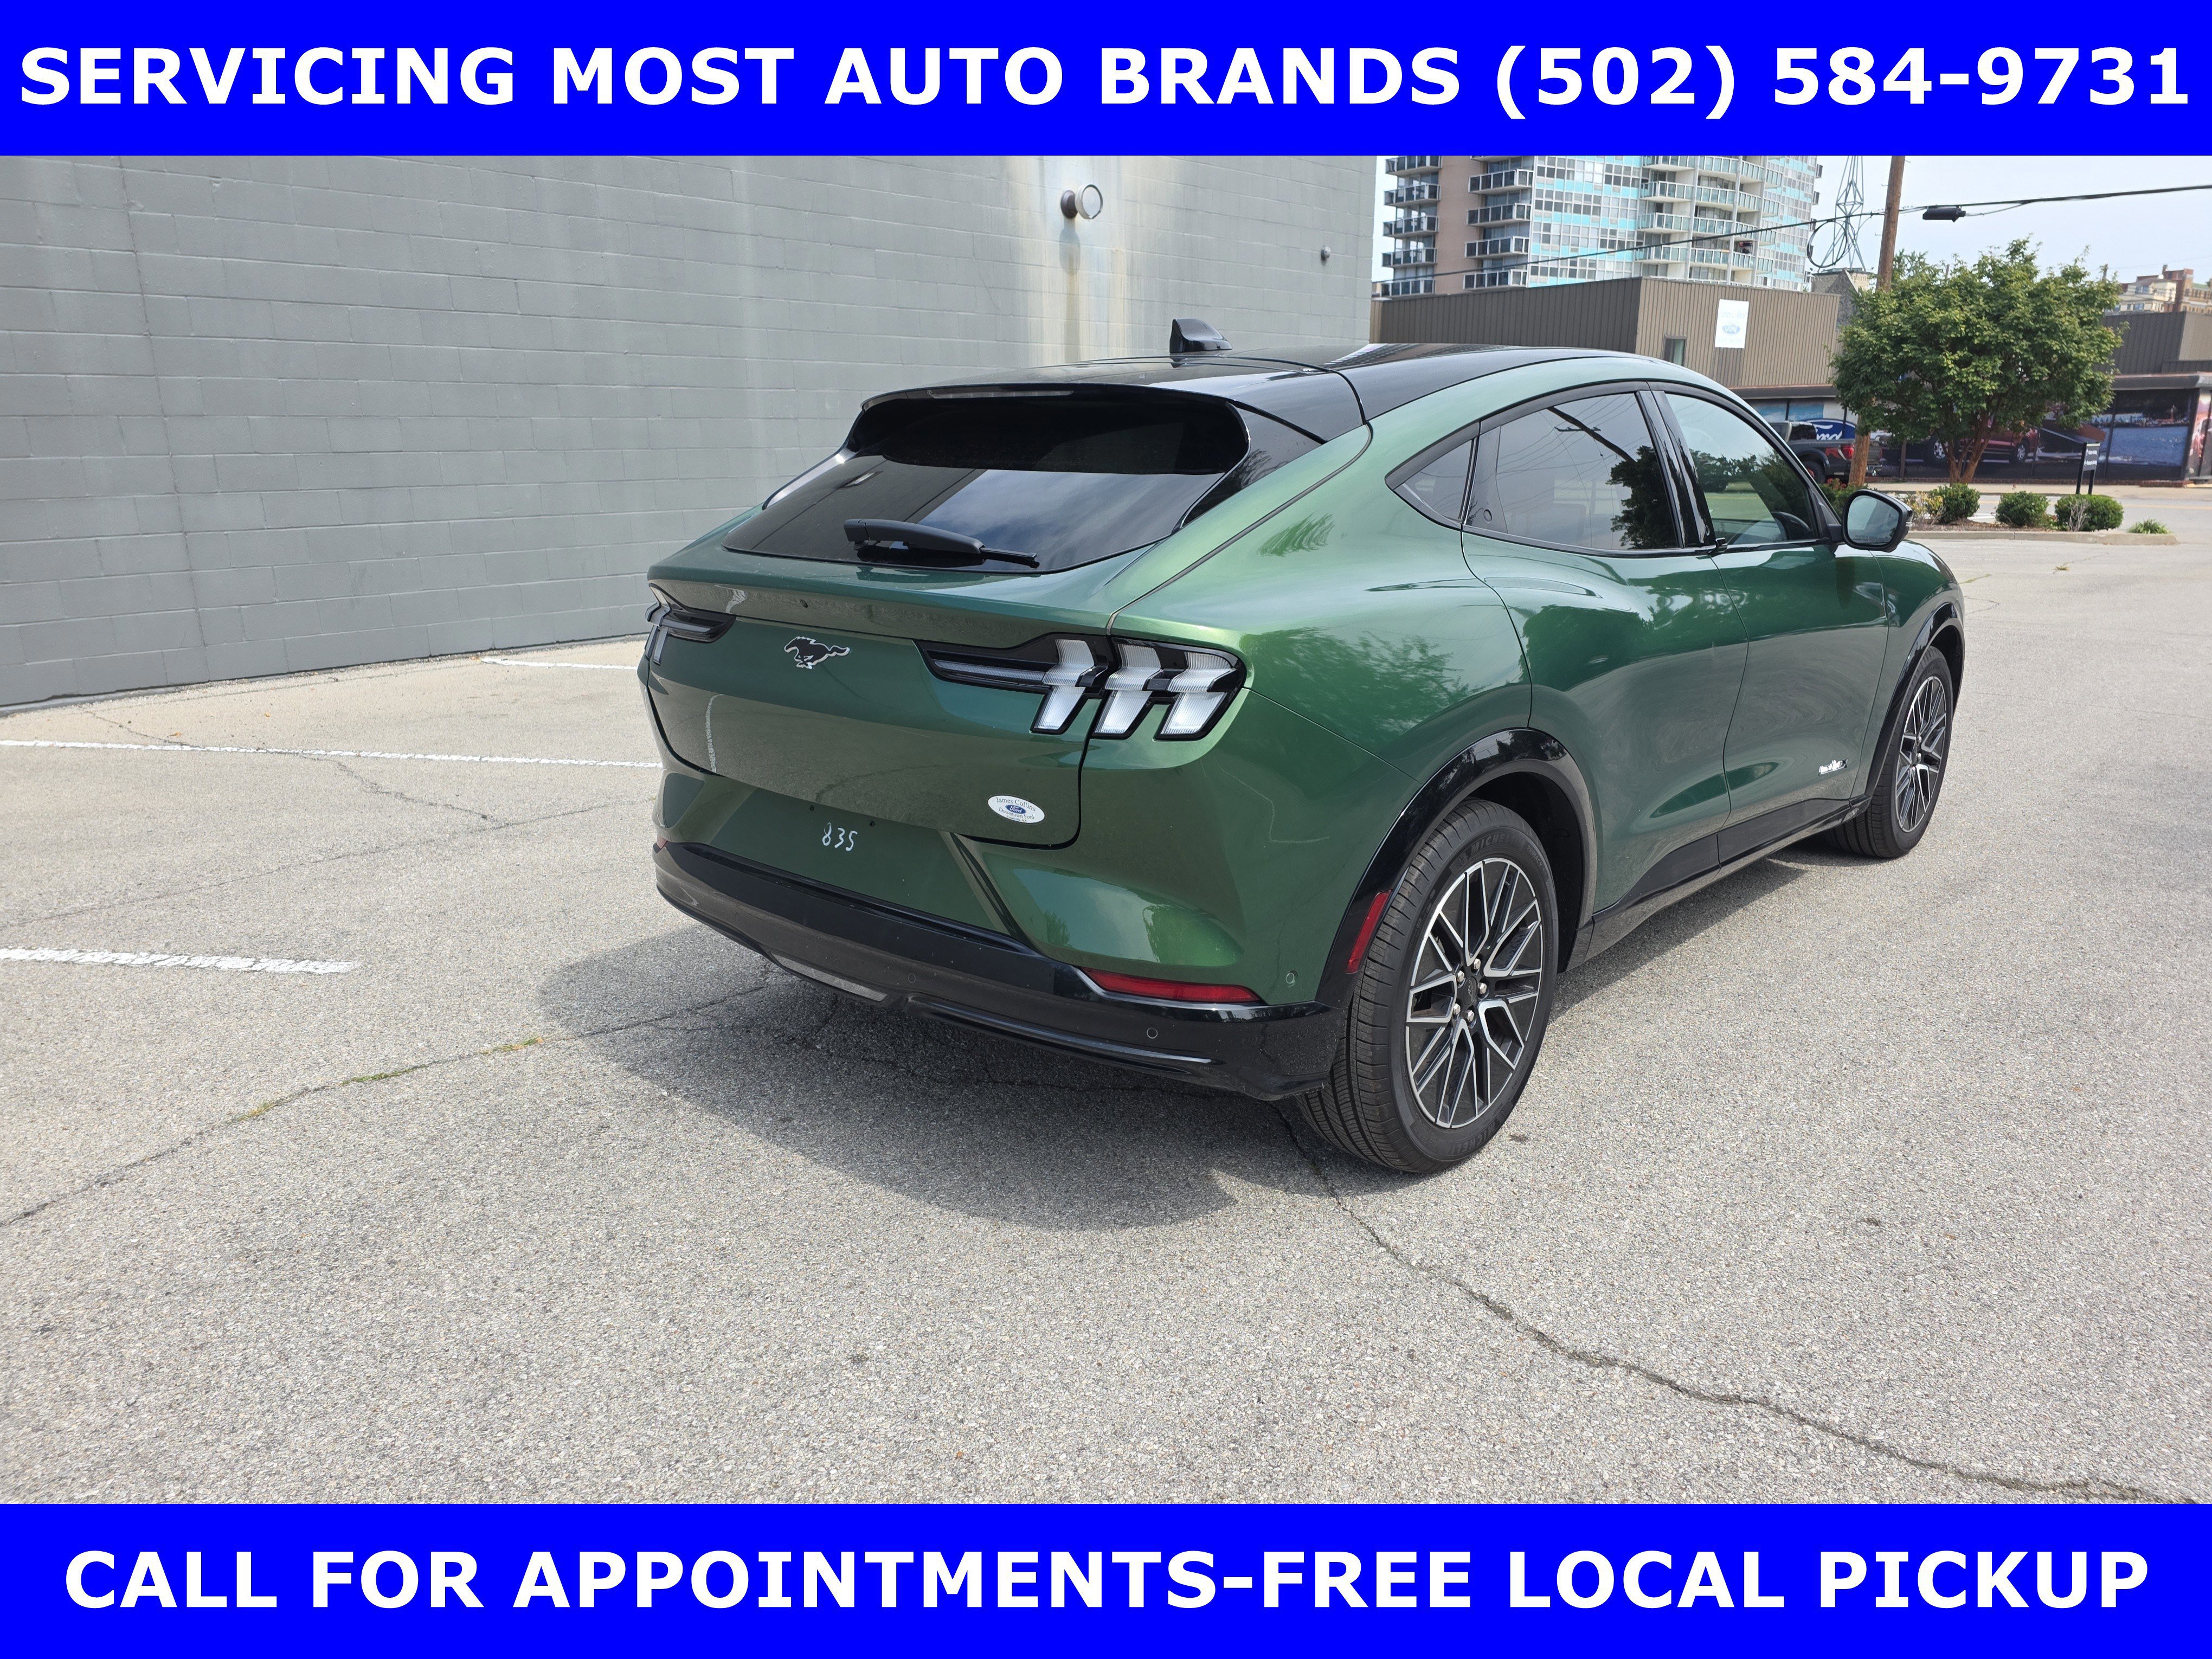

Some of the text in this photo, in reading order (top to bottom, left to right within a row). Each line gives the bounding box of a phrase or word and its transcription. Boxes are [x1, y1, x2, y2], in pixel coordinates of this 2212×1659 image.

[1014, 799, 1036, 812] Collins
[999, 807, 1023, 818] Downtown
[822, 822, 858, 852] 835
